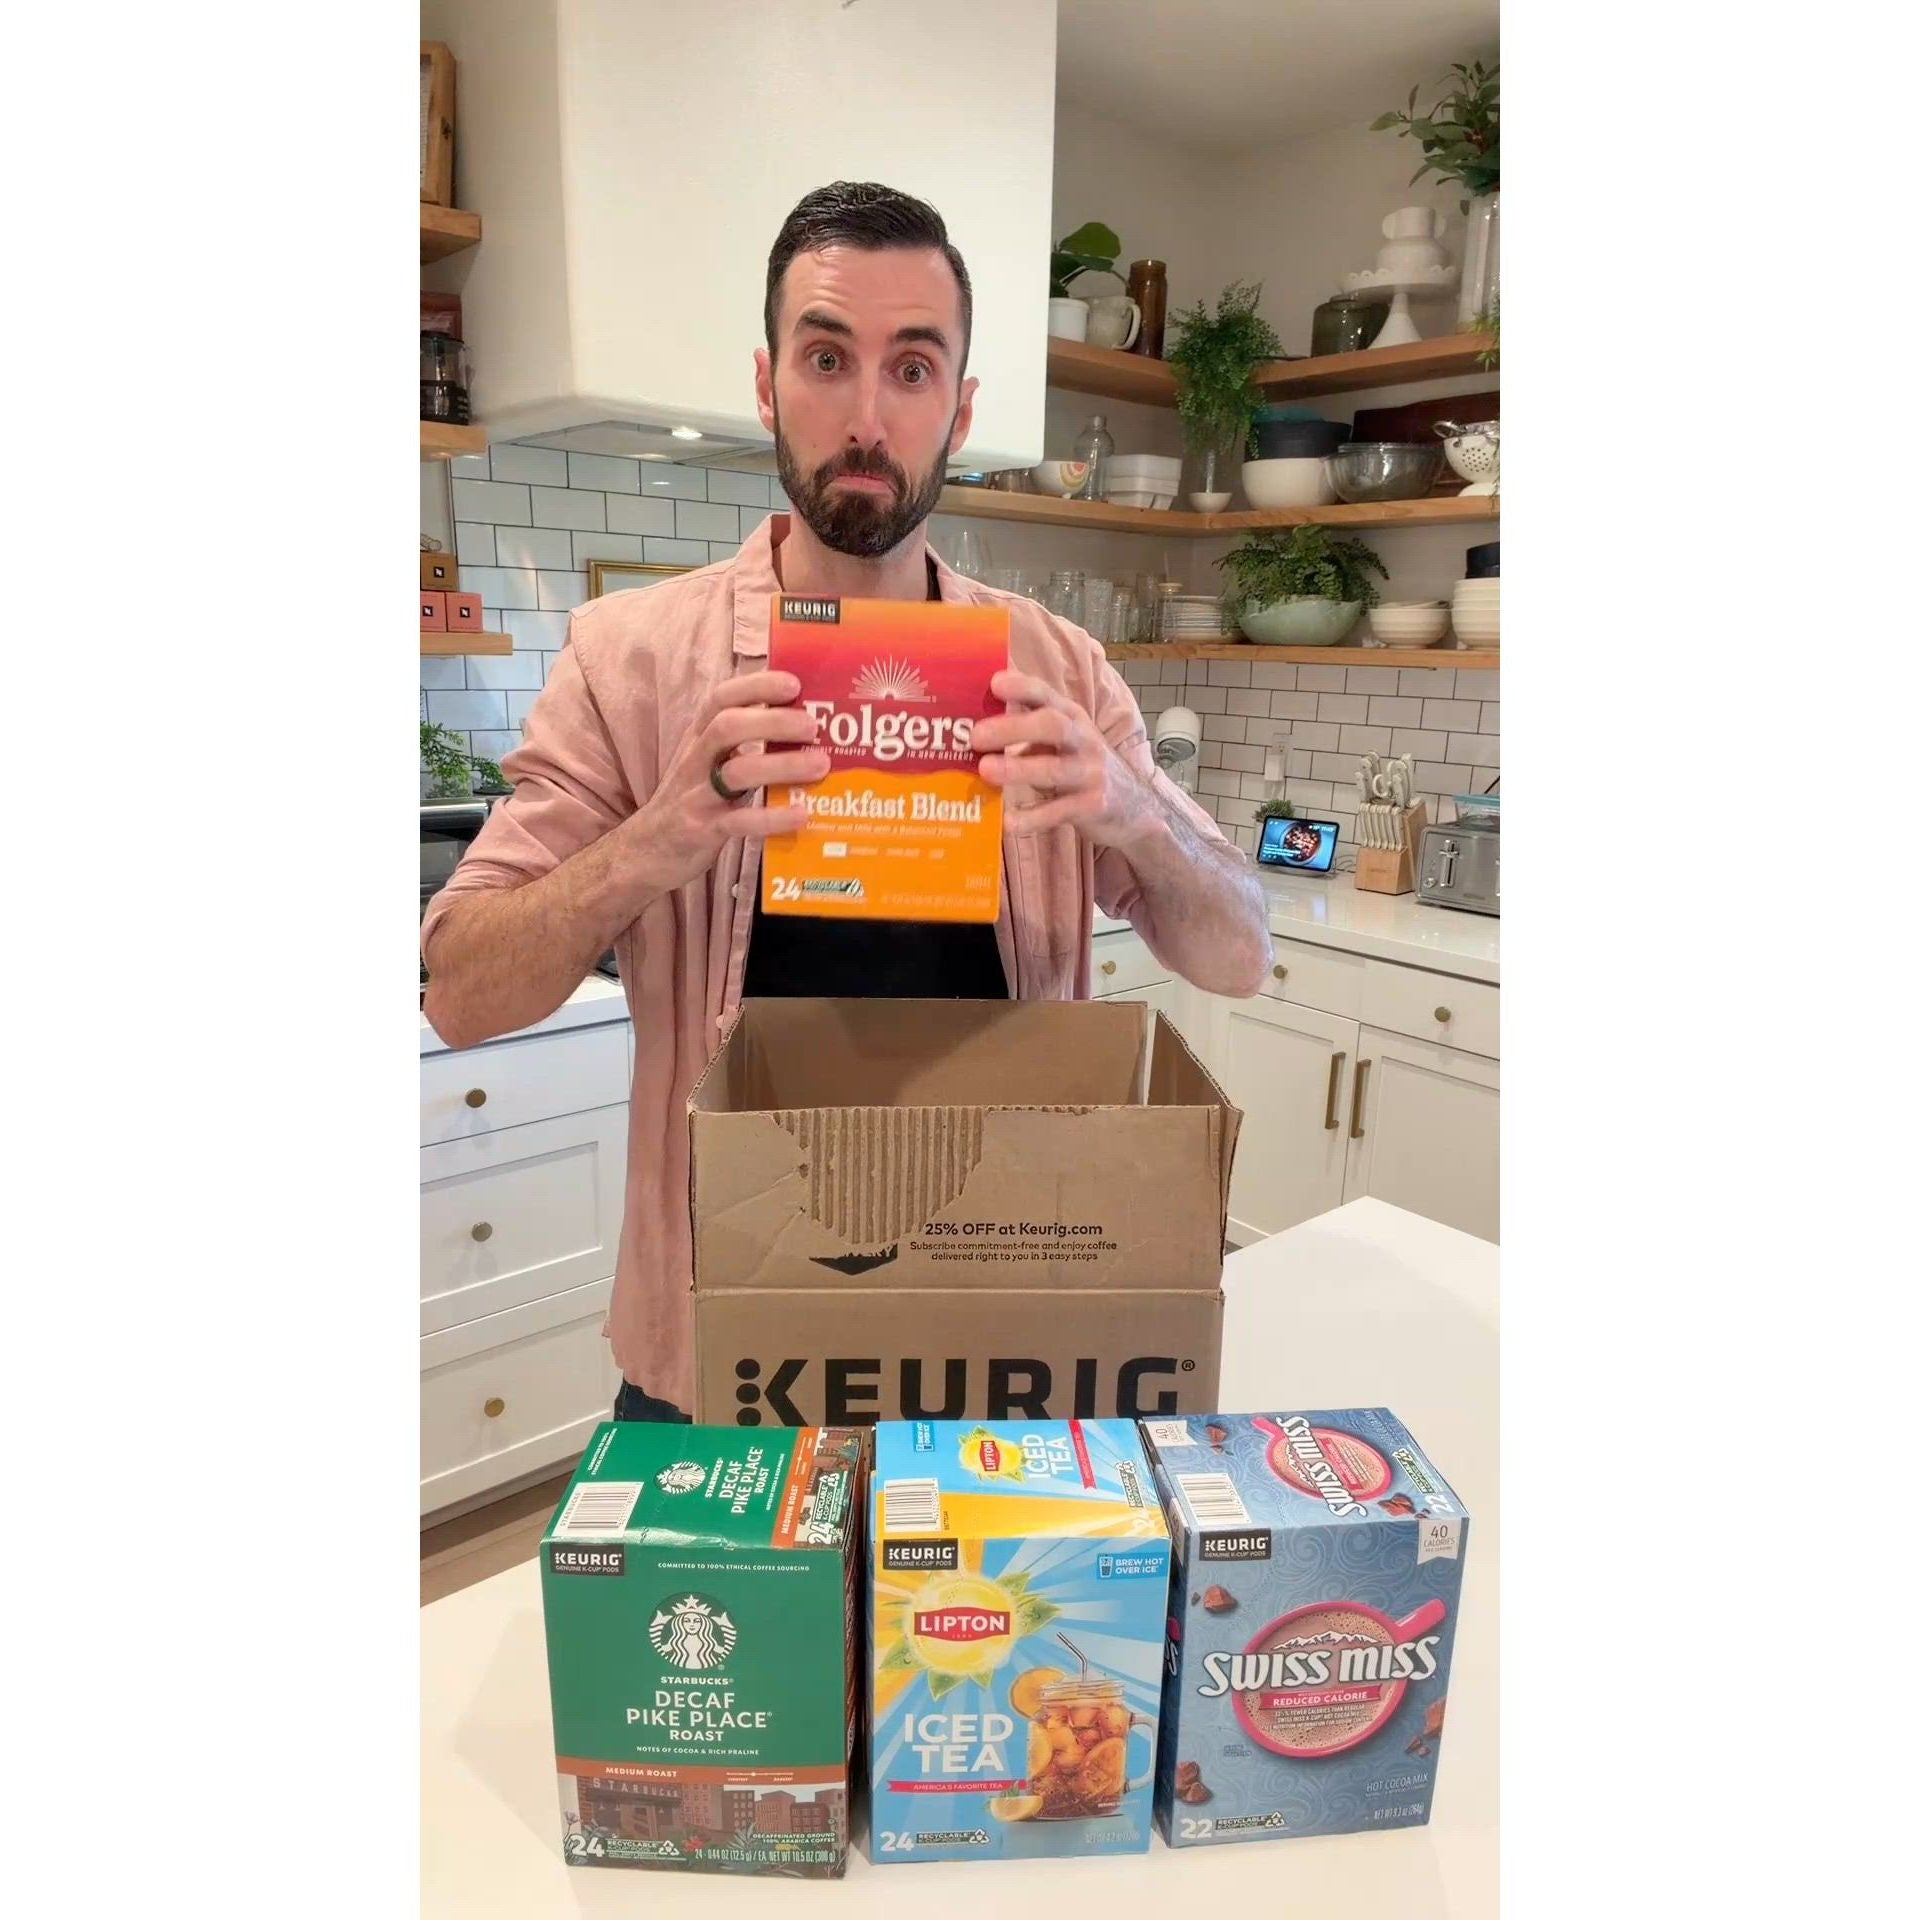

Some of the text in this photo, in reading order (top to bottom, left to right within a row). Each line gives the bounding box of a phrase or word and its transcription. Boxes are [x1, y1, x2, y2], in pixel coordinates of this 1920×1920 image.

[784, 601, 836, 616] KEURIG
[803, 700, 974, 761] Folgers
[911, 792, 982, 823] Blend
[771, 876, 801, 902] 24
[925, 1222, 1103, 1238] 25% OFF at Keurig.com
[910, 1241, 1117, 1252] Subscribe commitment-free and enjoy coffee
[931, 1252, 1098, 1263] delivered right to you in 3 easy steps
[1276, 1416, 1324, 1459] MISS
[983, 1441, 995, 1471] LIPTON
[1021, 1434, 1048, 1479] ICED
[1047, 1436, 1075, 1475] TEA
[704, 1457, 723, 1498] STARBUCKS
[719, 1460, 743, 1498] DECAF
[731, 1446, 764, 1514] PIKE PLACE
[754, 1467, 769, 1494] ROAST
[1303, 1461, 1368, 1517] SWISS
[781, 1485, 798, 1534] MEDIUM ROAST
[815, 1485, 828, 1520] RECYCLABLE
[1425, 1494, 1454, 1513] 22
[807, 1521, 834, 1545] 24
[1430, 1525, 1448, 1538] 40
[1205, 1537, 1266, 1551] KEURIG
[1423, 1537, 1456, 1547] CALORIES
[555, 1552, 619, 1566] KEURIG
[888, 1546, 953, 1560] KEURIG
[1115, 1557, 1163, 1567] BREW HOT
[1115, 1565, 1157, 1575] OVER ICE
[920, 1615, 1005, 1633] LIPTON
[1197, 1651, 1331, 1698] SWISS
[1338, 1636, 1441, 1681] MISS
[661, 1676, 729, 1686] STARBUCKS
[655, 1691, 736, 1709] DECAF
[1273, 1695, 1321, 1706] REDUCED
[1323, 1691, 1368, 1703] CALORIE
[626, 1708, 768, 1729] PIKE PLACE
[904, 1713, 1014, 1743] ICED
[669, 1730, 725, 1742] ROAST
[912, 1745, 1004, 1773] TEA
[605, 1767, 678, 1778] MEDIUM ROAST
[1366, 1780, 1383, 1792] HOT
[1385, 1776, 1411, 1790] COCOA
[1413, 1772, 1429, 1784] MIX
[1180, 1818, 1213, 1838] 22
[1217, 1816, 1265, 1825] RECYCLABLE
[571, 1834, 605, 1857] 24
[607, 1840, 657, 1848] RECYCLABLE
[880, 1831, 914, 1851] 24
[769, 1850, 780, 1861] NET
